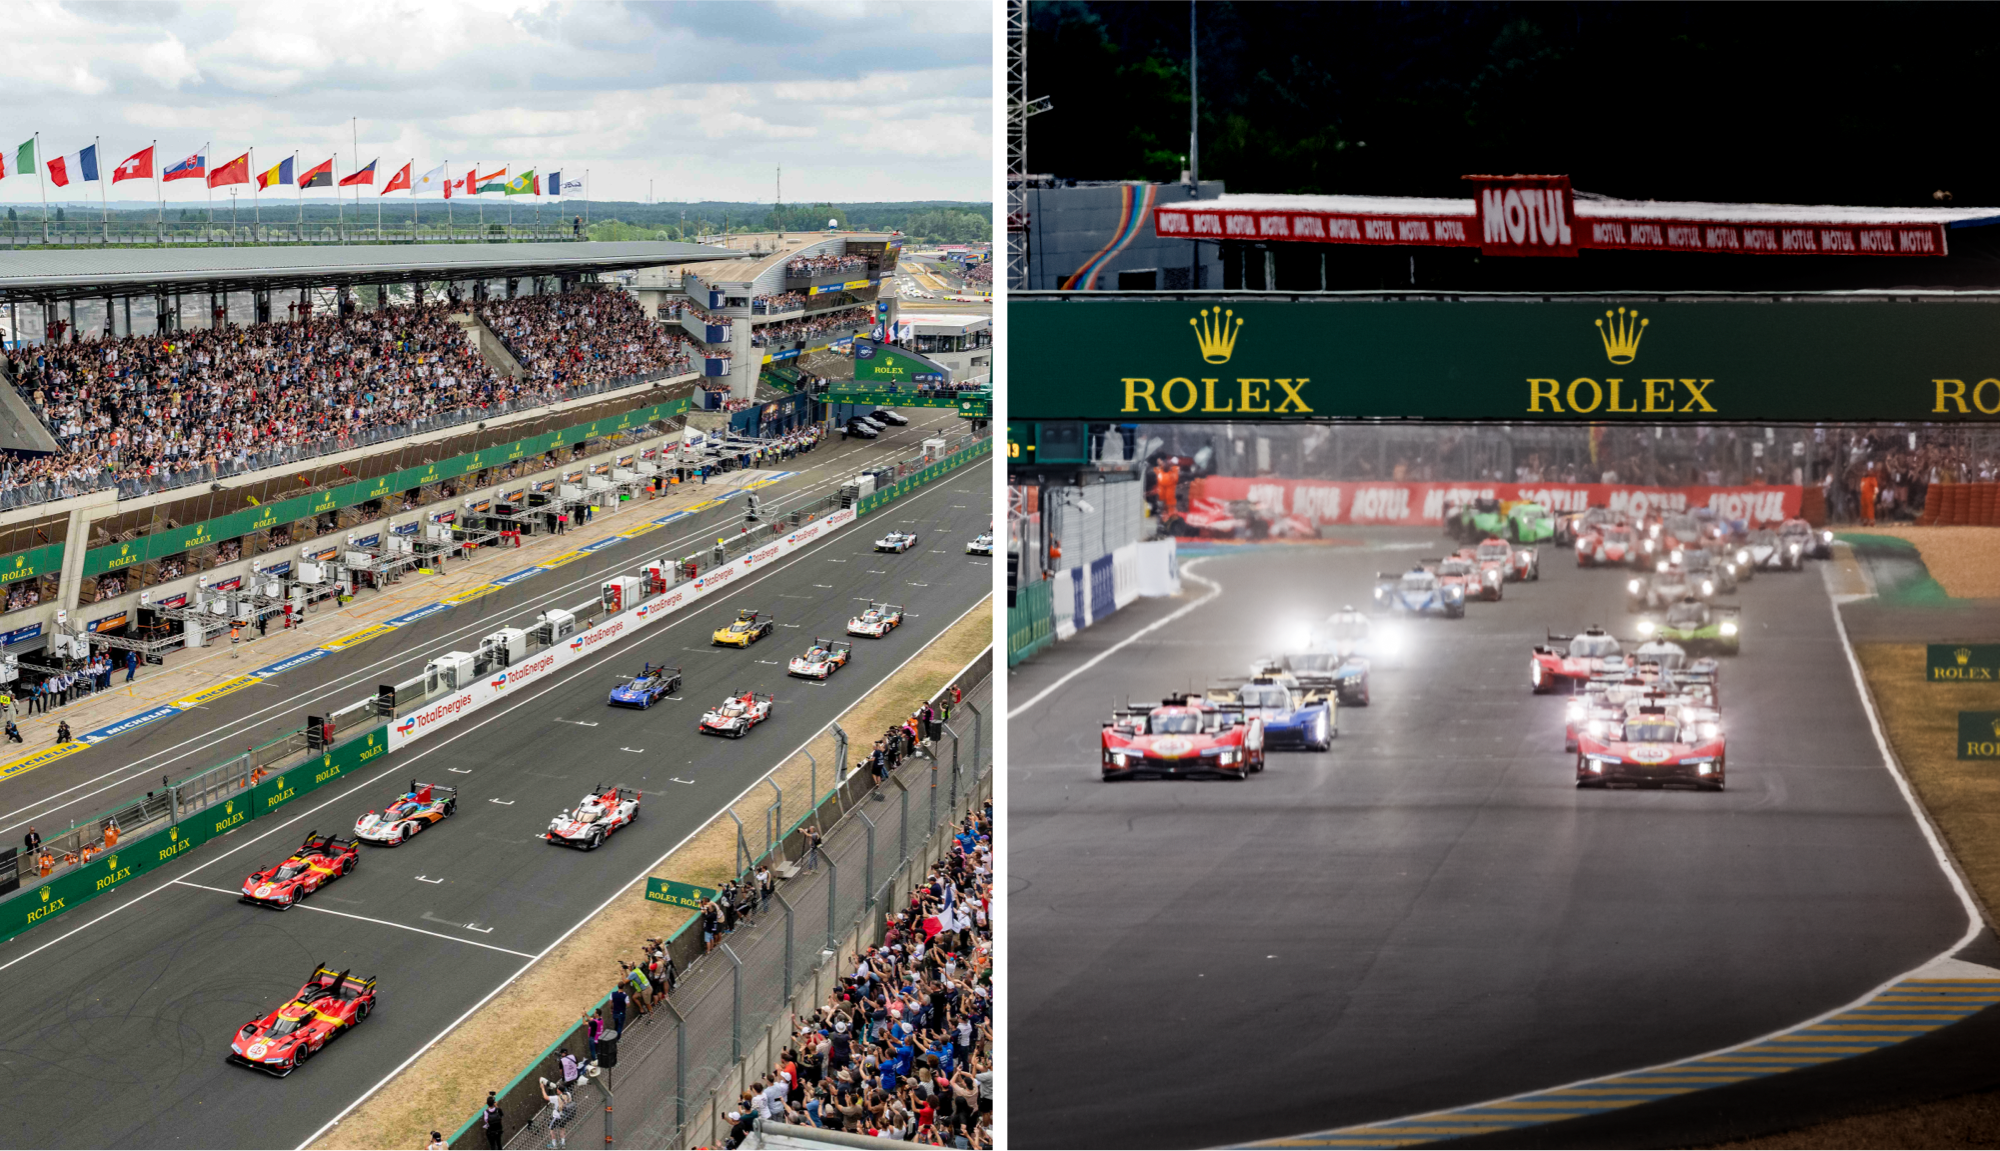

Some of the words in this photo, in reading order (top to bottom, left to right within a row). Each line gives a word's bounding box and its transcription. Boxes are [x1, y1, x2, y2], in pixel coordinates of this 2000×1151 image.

[1482, 188, 1572, 246] MOTUL
[1593, 222, 1626, 244] MOTUL
[1630, 224, 1662, 245] MOTUL
[1668, 226, 1702, 247] MOTUL
[1706, 226, 1739, 249] MOTUL
[1744, 229, 1778, 250] MOTUL
[1782, 230, 1816, 250] MOTUL
[1821, 230, 1855, 250] MOTUL
[1860, 230, 1894, 251] MOTUL
[1899, 230, 1934, 252] MOTUL
[1120, 377, 1314, 414] ROLEX
[1526, 377, 1718, 413] ROLEX
[420, 474, 439, 484] ROLEX
[370, 486, 389, 497] ROLEX
[315, 501, 336, 512] ROLEX
[1350, 488, 1411, 519] MOTUL
[252, 516, 277, 529] ROLEX
[185, 534, 212, 548] ROLEX
[795, 526, 819, 543] TotalEnergies
[108, 554, 137, 568] ROLEX
[752, 545, 779, 563] TotalEnergies
[1, 567, 34, 582] ROLEX
[704, 567, 734, 588] TotalEnergies
[403, 604, 446, 621] MICHELIN
[648, 592, 683, 615] TotalEnergies
[342, 626, 388, 645] MICHELIN
[583, 620, 624, 647] TotalEnergies
[274, 650, 324, 672] MICHELIN
[507, 654, 554, 684] TotalEnergies
[1934, 667, 1992, 679] ROLEX
[195, 677, 253, 701] MICHELIN
[416, 693, 472, 728] TotalEnergies
[105, 708, 172, 735] MICHELIN
[4, 744, 79, 774] MICHELIN
[360, 744, 383, 762] ROLEX
[316, 764, 340, 783] ROLEX
[268, 787, 295, 806] ROLEX
[215, 810, 244, 833] ROLEX
[159, 837, 190, 861] ROLEX
[96, 866, 131, 891] ROLEX
[648, 891, 678, 903] ROLEX
[680, 898, 700, 908] ROL
[27, 897, 65, 924] ROLEX
